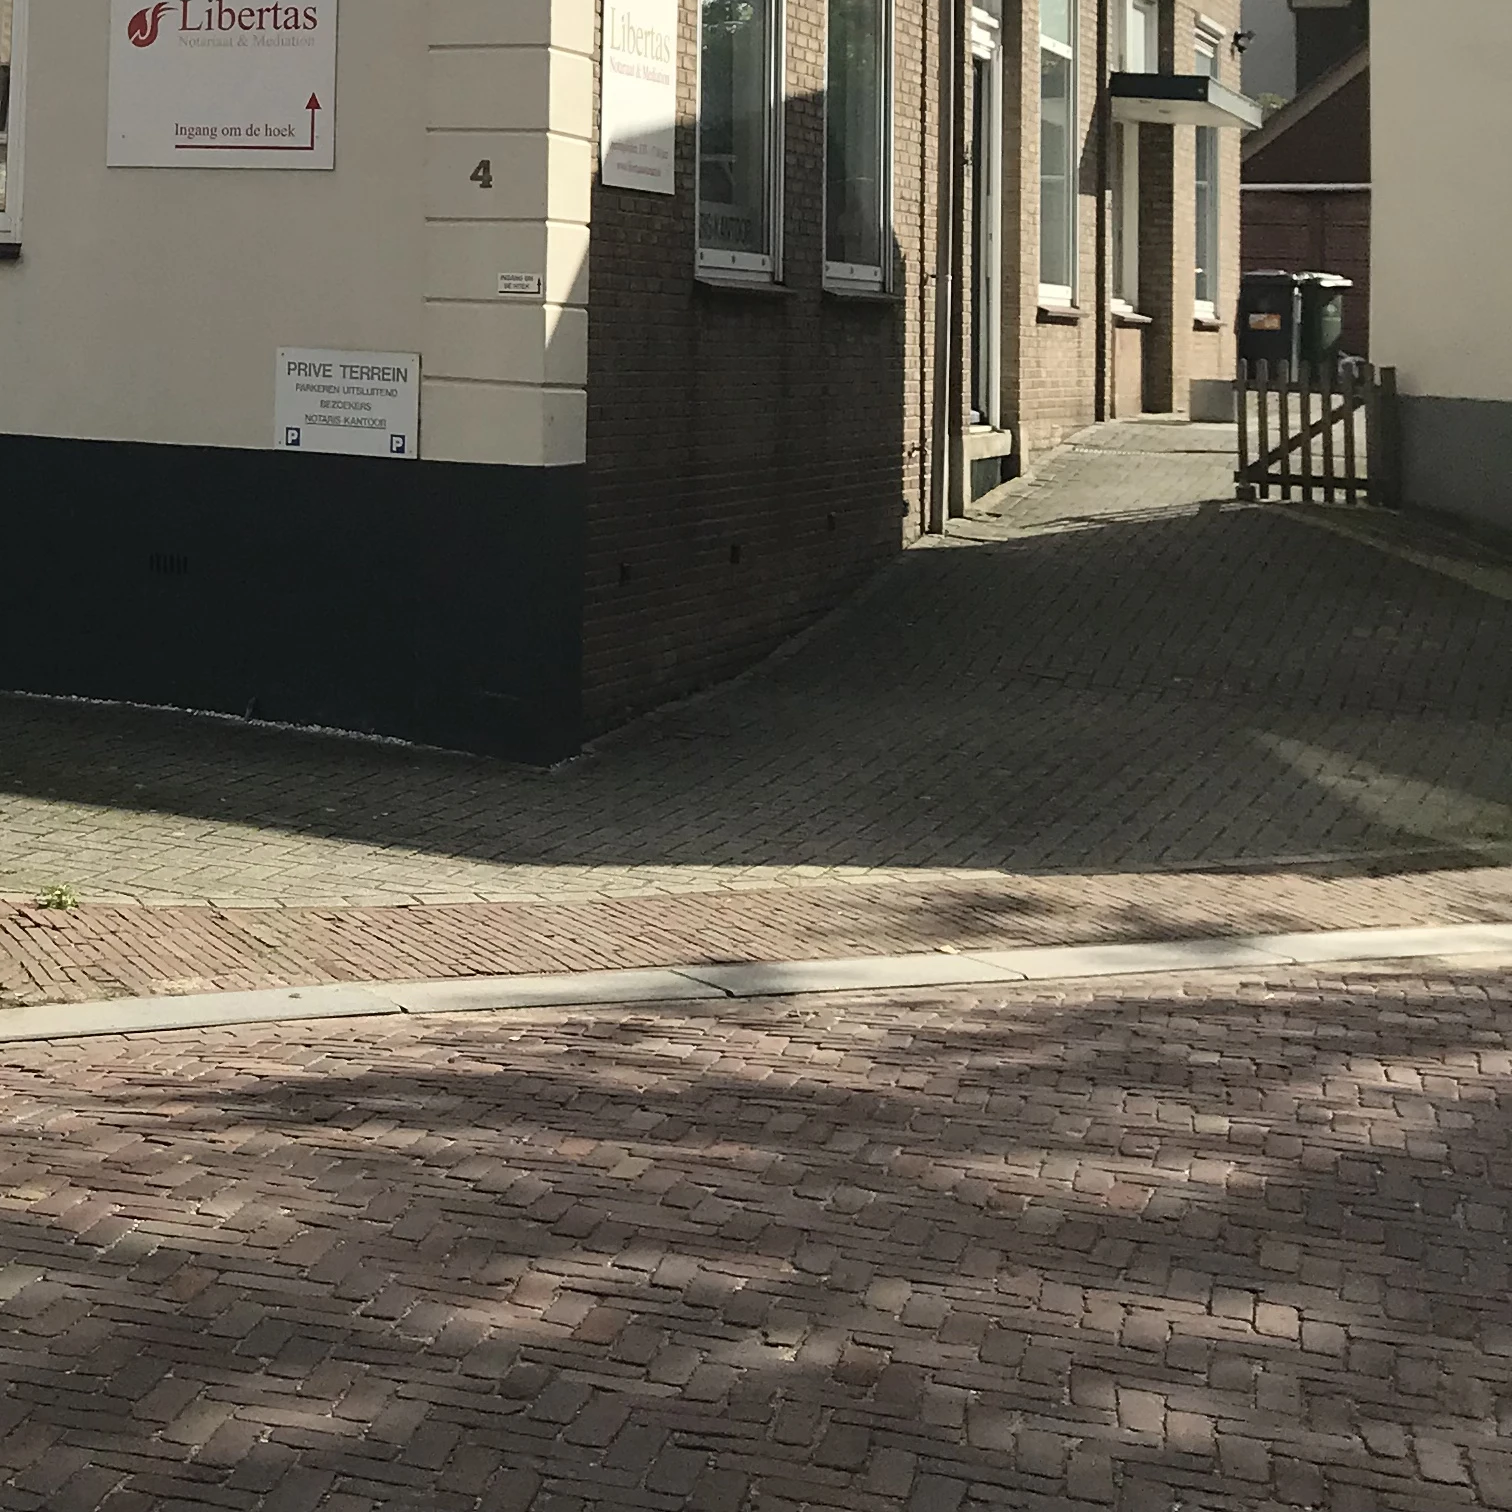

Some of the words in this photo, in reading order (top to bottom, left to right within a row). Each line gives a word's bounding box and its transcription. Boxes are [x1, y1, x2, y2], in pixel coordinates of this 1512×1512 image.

[609, 6, 671, 64] Libertas
[174, 123, 218, 140] Ingang
[221, 126, 242, 137] om
[245, 123, 261, 137] de
[264, 123, 296, 137] hoek
[469, 159, 493, 188] 4
[287, 361, 333, 378] PRIVE
[339, 364, 408, 383] TERREIN
[295, 383, 340, 394] PARKEREN
